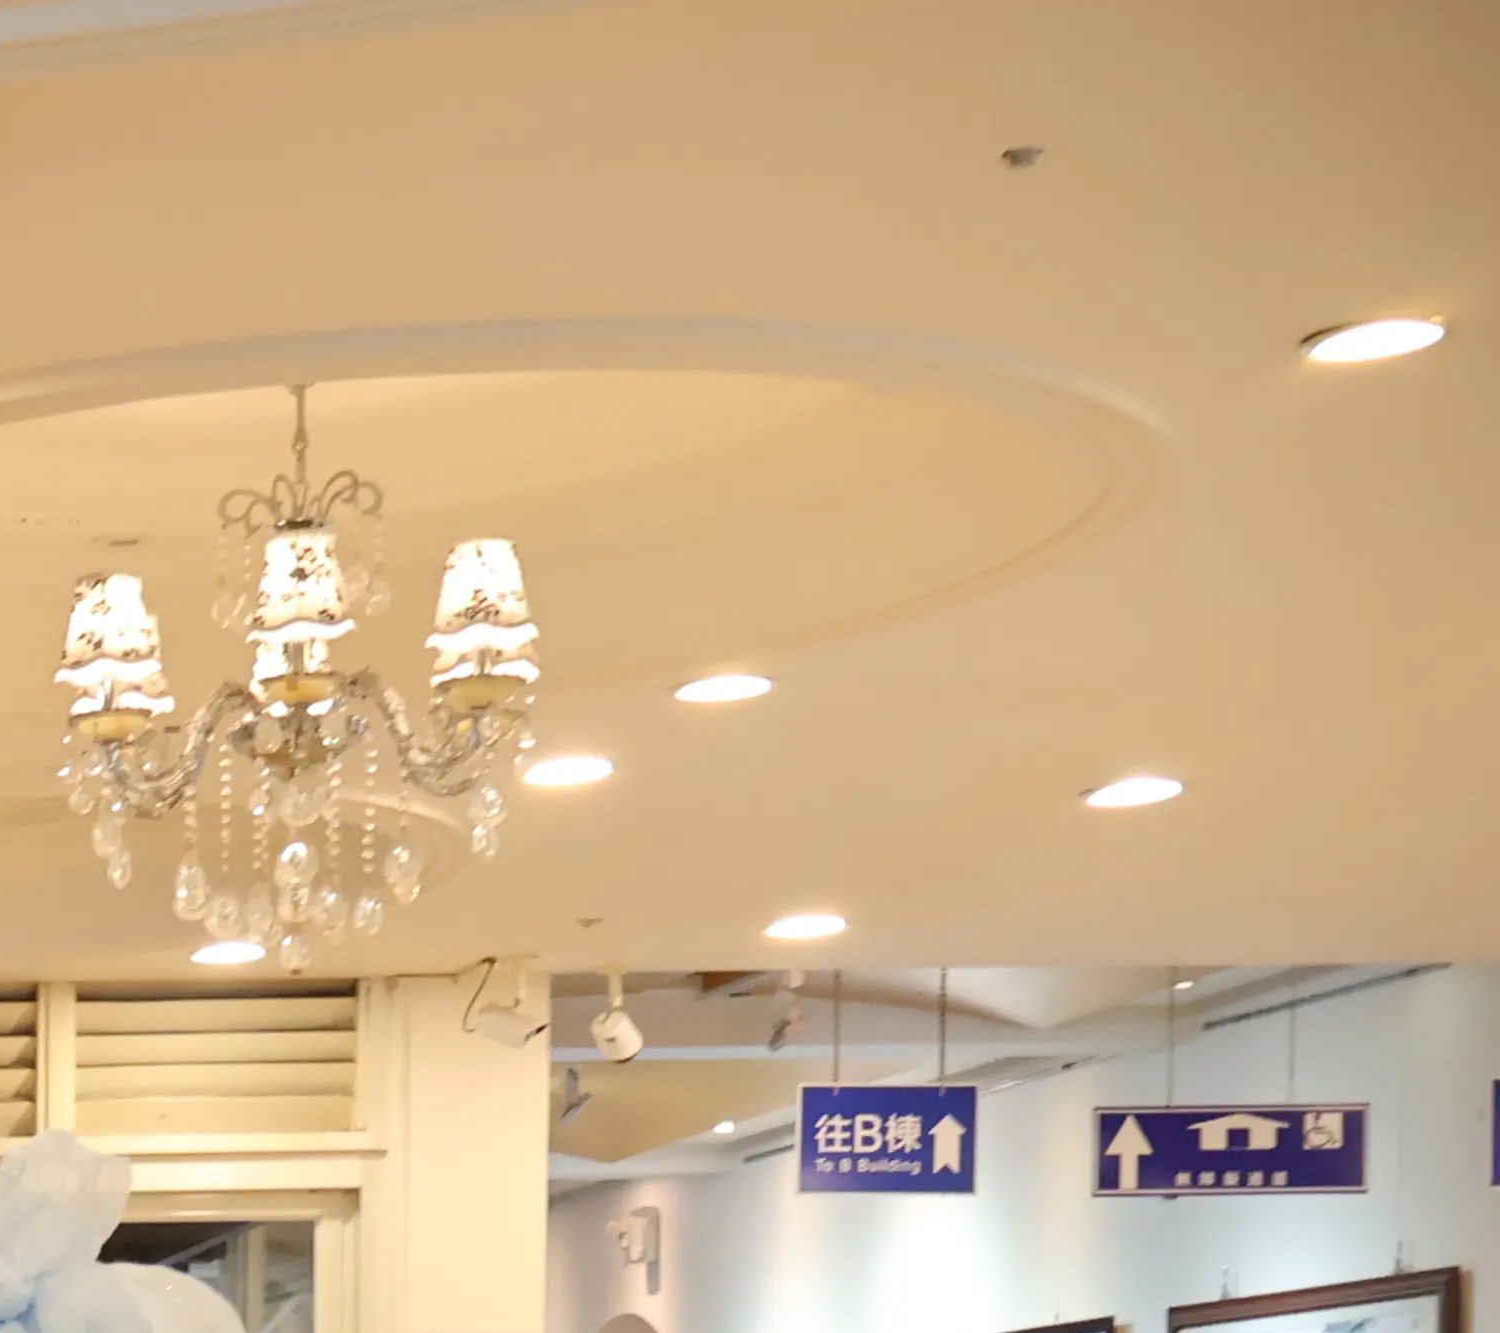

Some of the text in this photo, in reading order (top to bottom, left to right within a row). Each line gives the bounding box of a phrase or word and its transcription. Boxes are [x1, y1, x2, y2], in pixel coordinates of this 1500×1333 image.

[814, 1112, 923, 1154] 往B棟
[814, 1157, 834, 1173] To
[857, 1157, 922, 1175] Building
